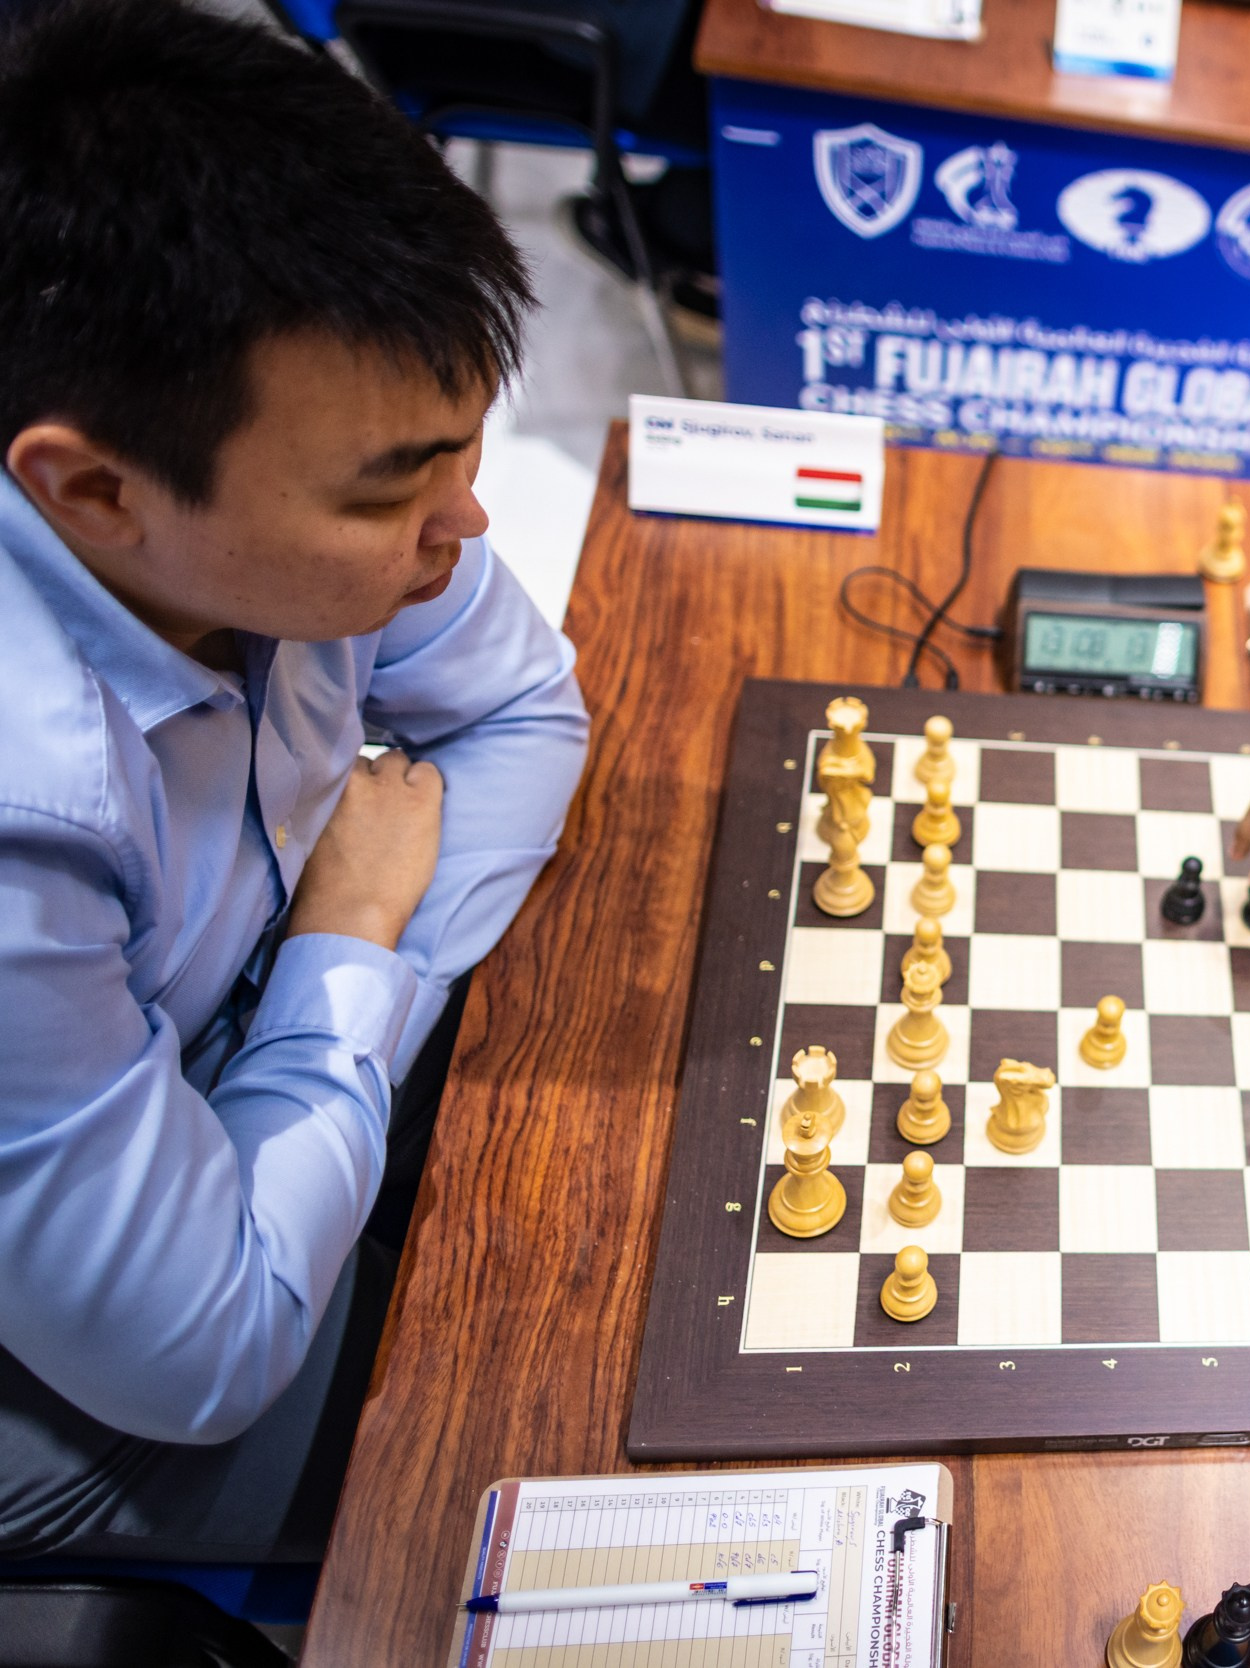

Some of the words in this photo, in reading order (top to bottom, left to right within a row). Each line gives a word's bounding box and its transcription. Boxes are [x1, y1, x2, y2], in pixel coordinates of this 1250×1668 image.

[874, 333, 1119, 410] FUJAIRAH
[799, 381, 952, 430] CHESS
[725, 1202, 742, 1213] g
[717, 1295, 735, 1306] h
[894, 1361, 911, 1373] 2
[999, 1360, 1016, 1371] 3
[1102, 1358, 1118, 1370] 4
[1202, 1357, 1218, 1367] 5
[1127, 1436, 1170, 1447] DGT
[874, 1530, 886, 1572] CHESS
